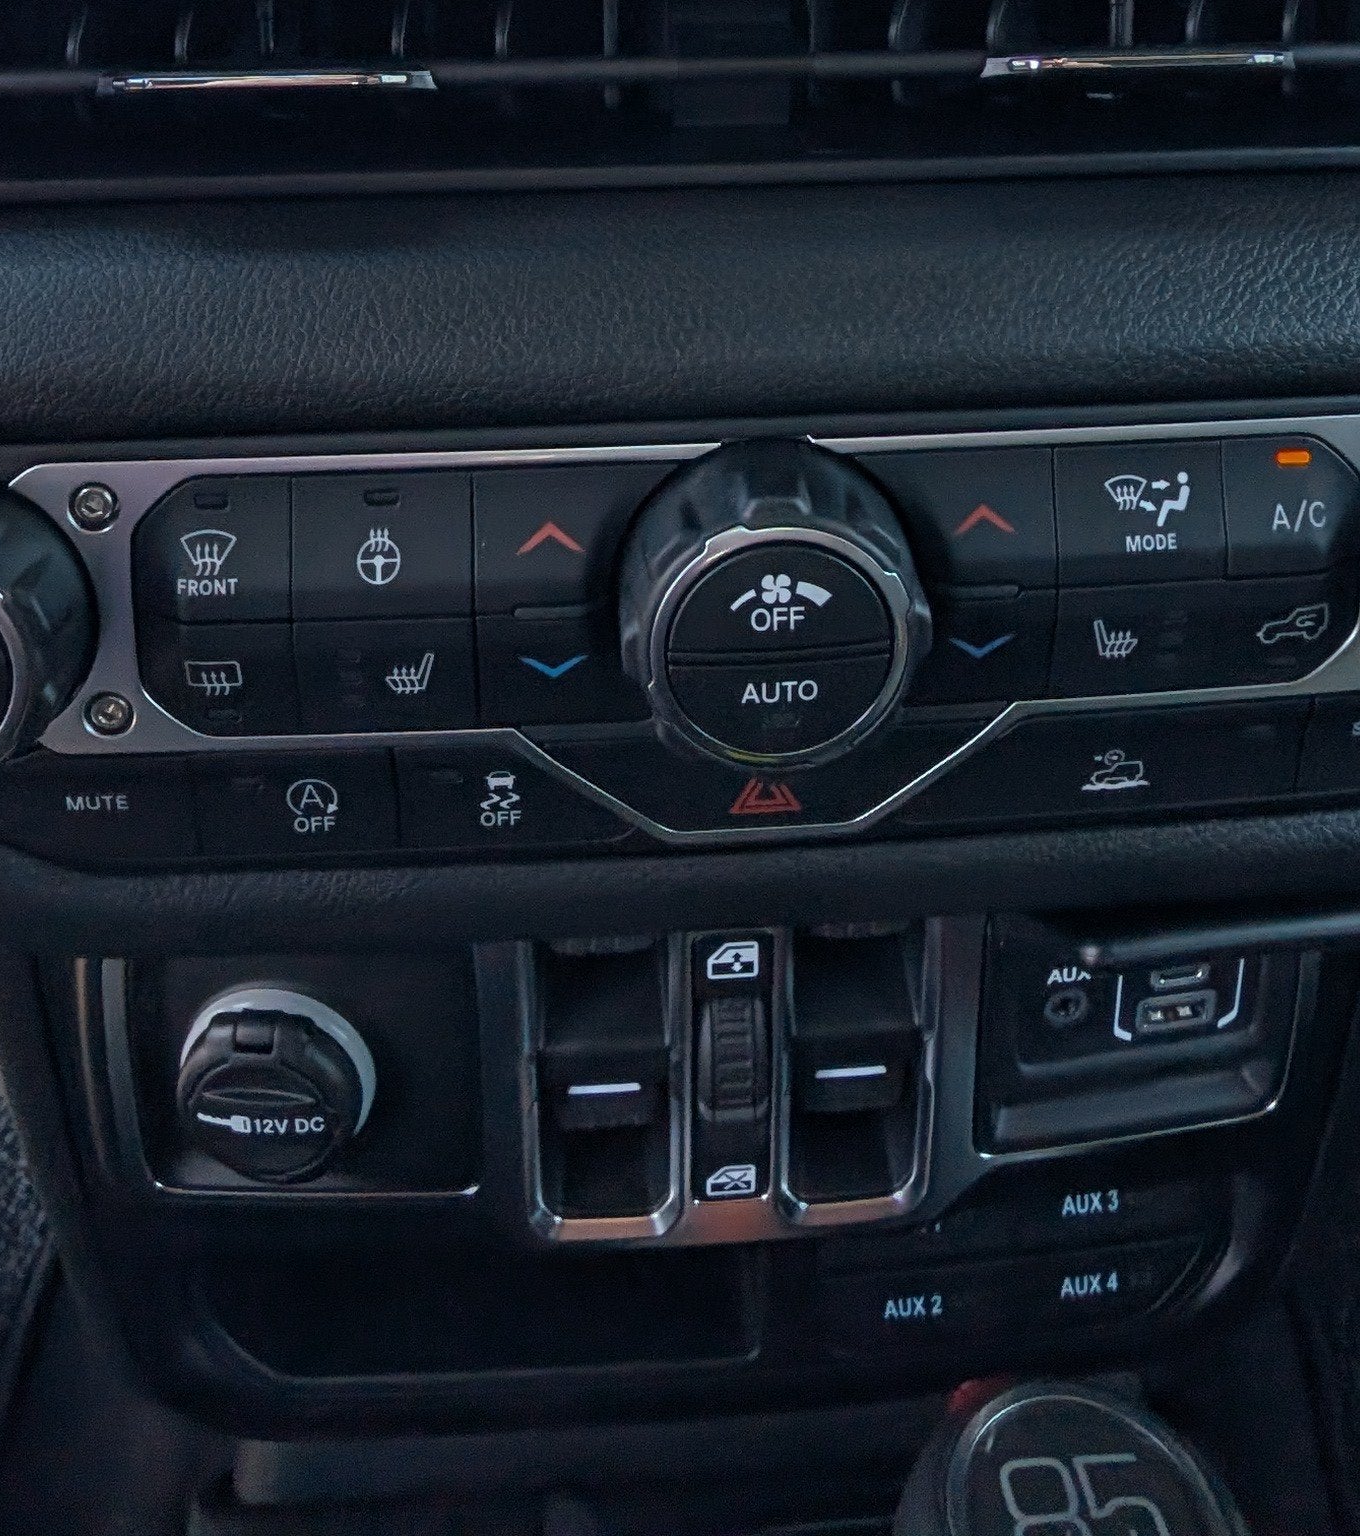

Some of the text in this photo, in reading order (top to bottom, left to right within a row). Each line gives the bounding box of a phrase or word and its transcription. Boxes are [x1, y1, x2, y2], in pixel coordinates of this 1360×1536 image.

[1270, 500, 1328, 533] A/C
[1125, 532, 1179, 553] MODE
[176, 577, 239, 597] FRONT
[749, 605, 806, 633] OFF
[740, 678, 819, 706] AUTO
[65, 793, 132, 813] MUTE
[297, 783, 322, 810] A
[293, 816, 337, 835] OFF
[480, 809, 523, 828] OFF
[252, 1115, 326, 1134] 12V DC
[1061, 1189, 1120, 1217] AUX 3
[1060, 1271, 1119, 1300] AUX 4
[883, 1295, 944, 1321] AUX 2
